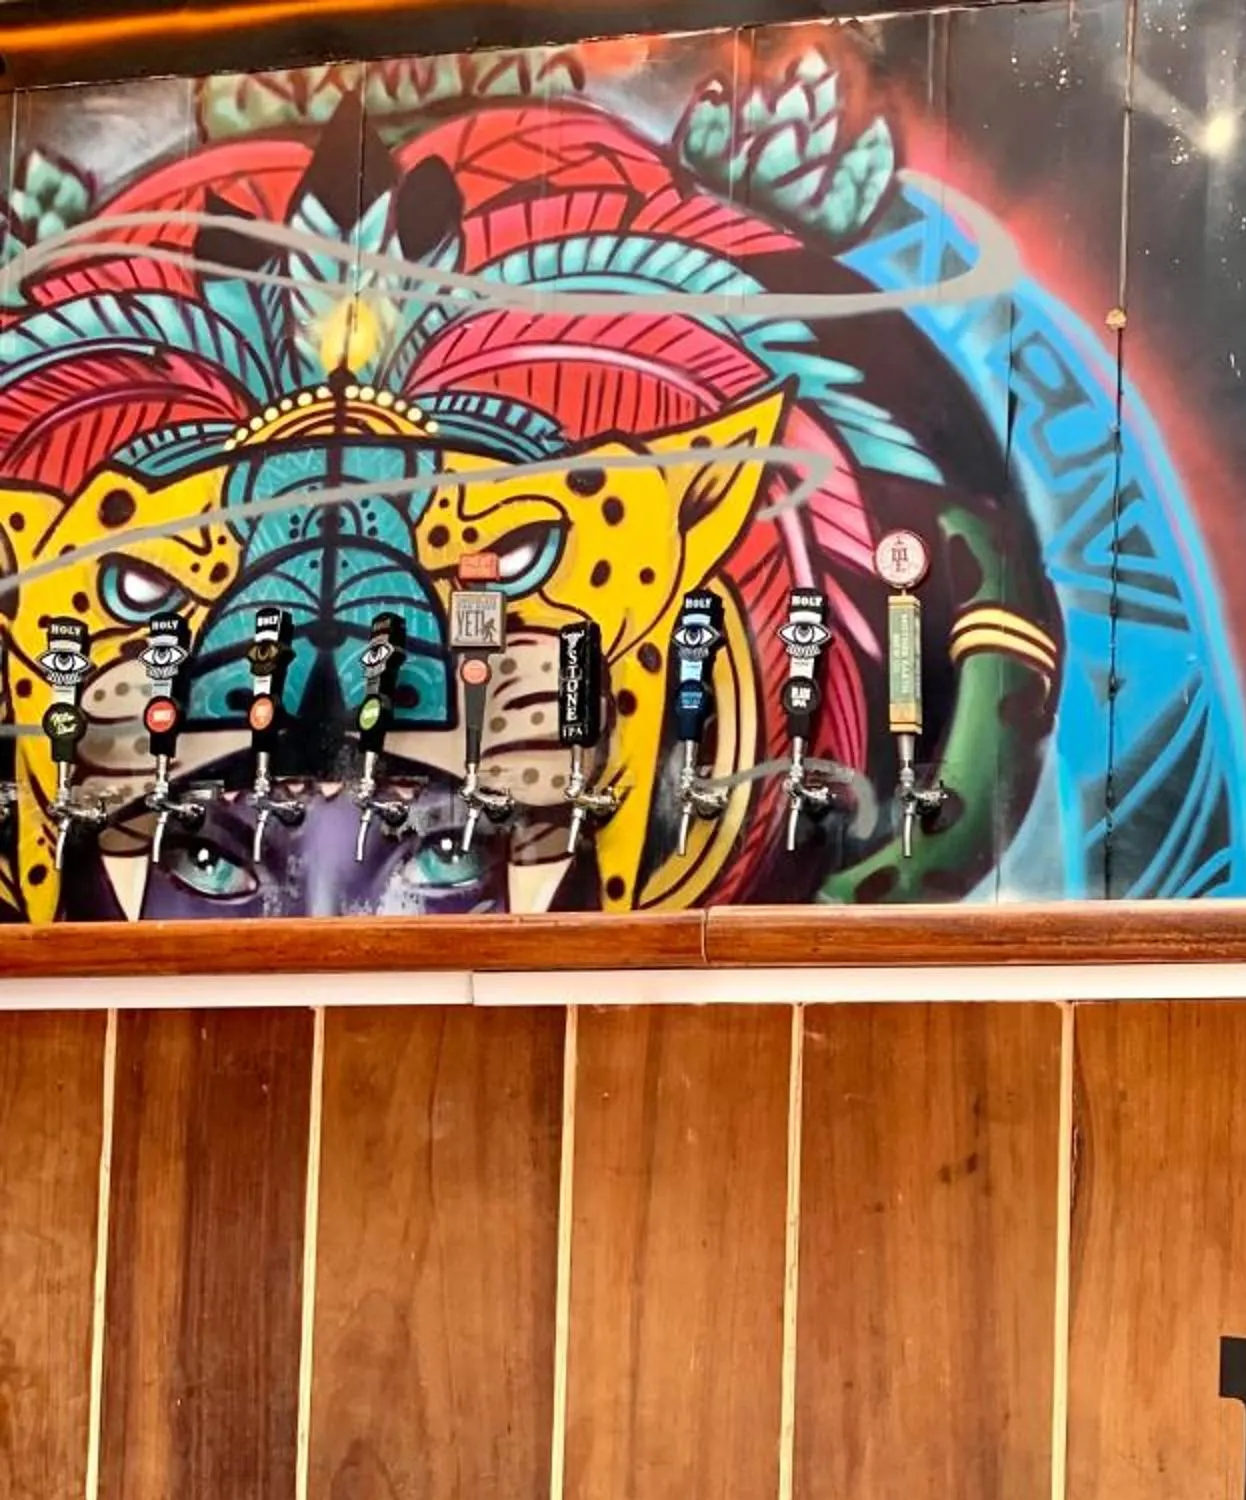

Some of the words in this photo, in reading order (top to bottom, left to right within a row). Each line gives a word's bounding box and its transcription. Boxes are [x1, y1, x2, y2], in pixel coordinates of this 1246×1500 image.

[685, 597, 712, 609] HOLY
[791, 595, 823, 607] HOLY
[151, 619, 179, 631] HOLY
[456, 610, 486, 637] YETI
[50, 624, 81, 636] HOLY
[565, 650, 580, 722] STONE
[562, 726, 583, 738] IPA
